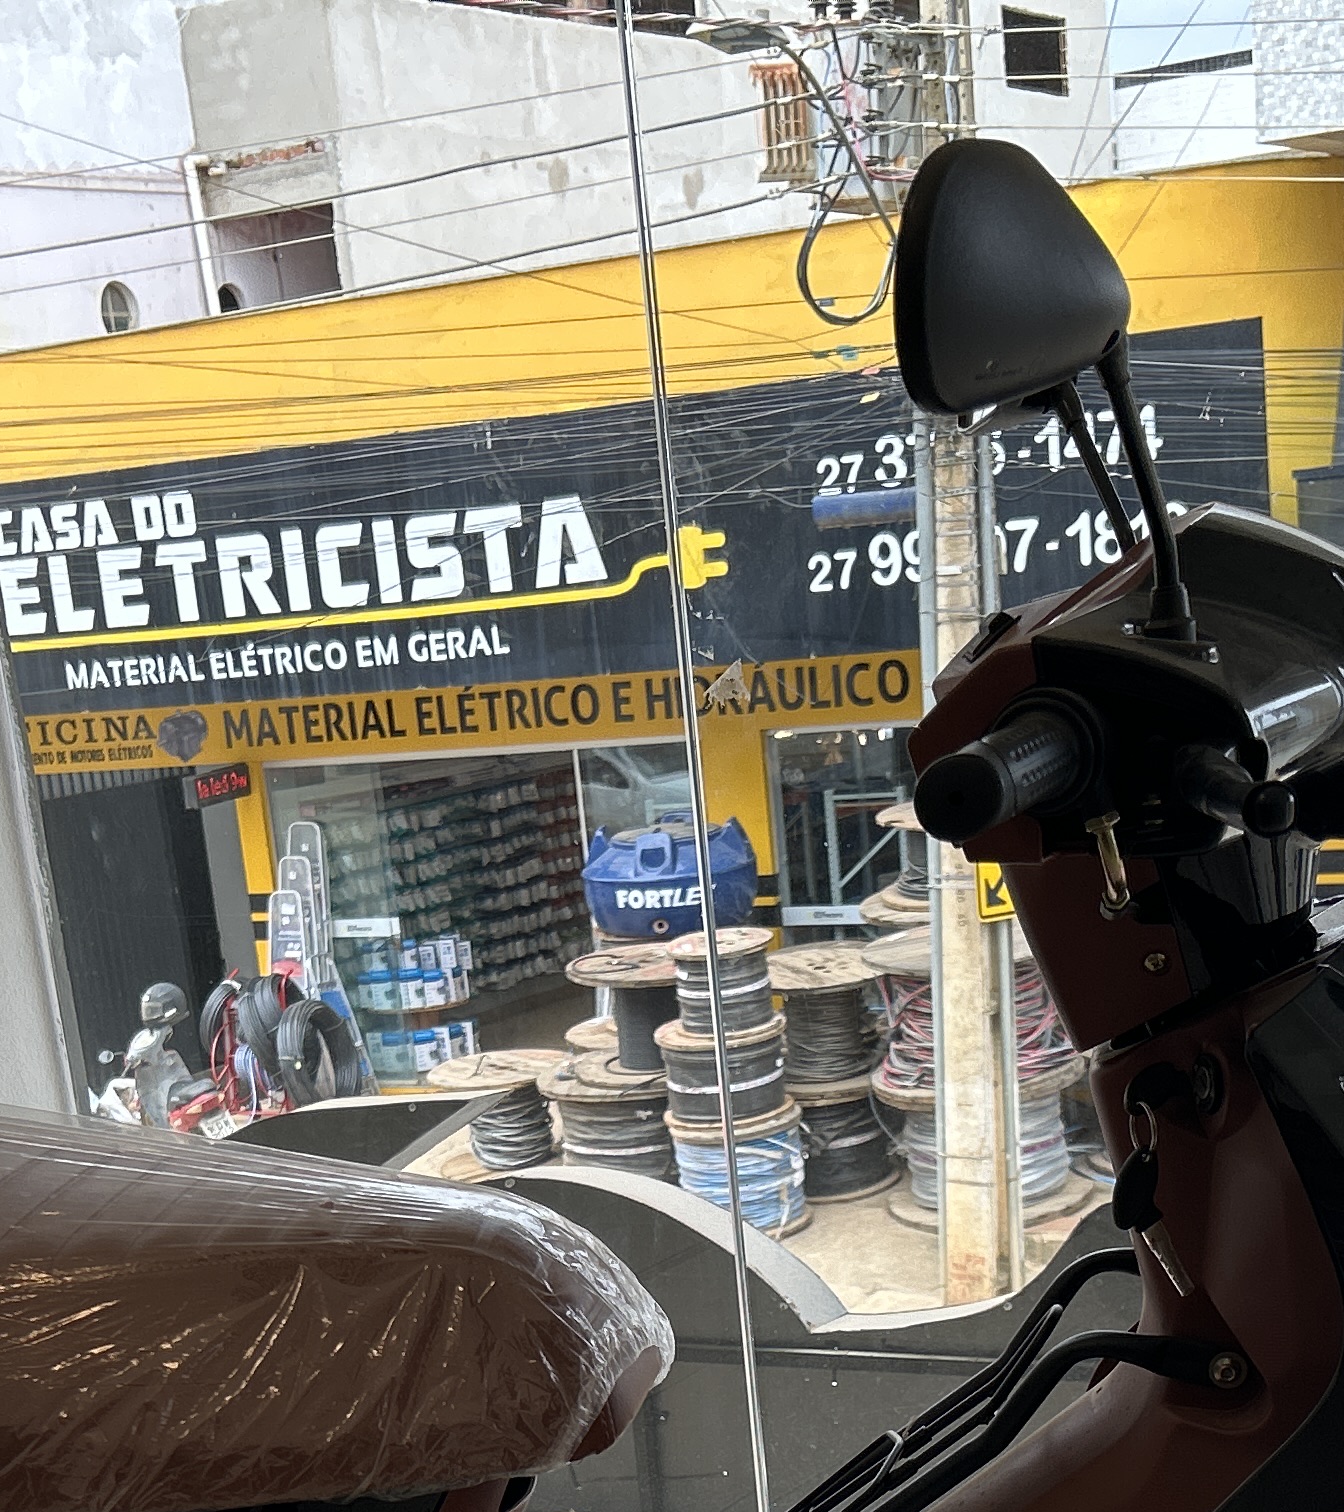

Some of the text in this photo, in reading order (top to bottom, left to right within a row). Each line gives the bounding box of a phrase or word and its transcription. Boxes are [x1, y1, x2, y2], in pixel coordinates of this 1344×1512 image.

[816, 453, 864, 495] 27
[131, 489, 197, 541] DO
[807, 547, 857, 593] 27
[65, 625, 510, 691] MATERIAL ELÉTRICO EM GERAL
[25, 714, 157, 747] ICINA
[223, 692, 408, 750] MATERIAL
[416, 680, 601, 740] ELÉTRICO
[615, 683, 638, 724] E
[615, 883, 717, 909] FORTLE
